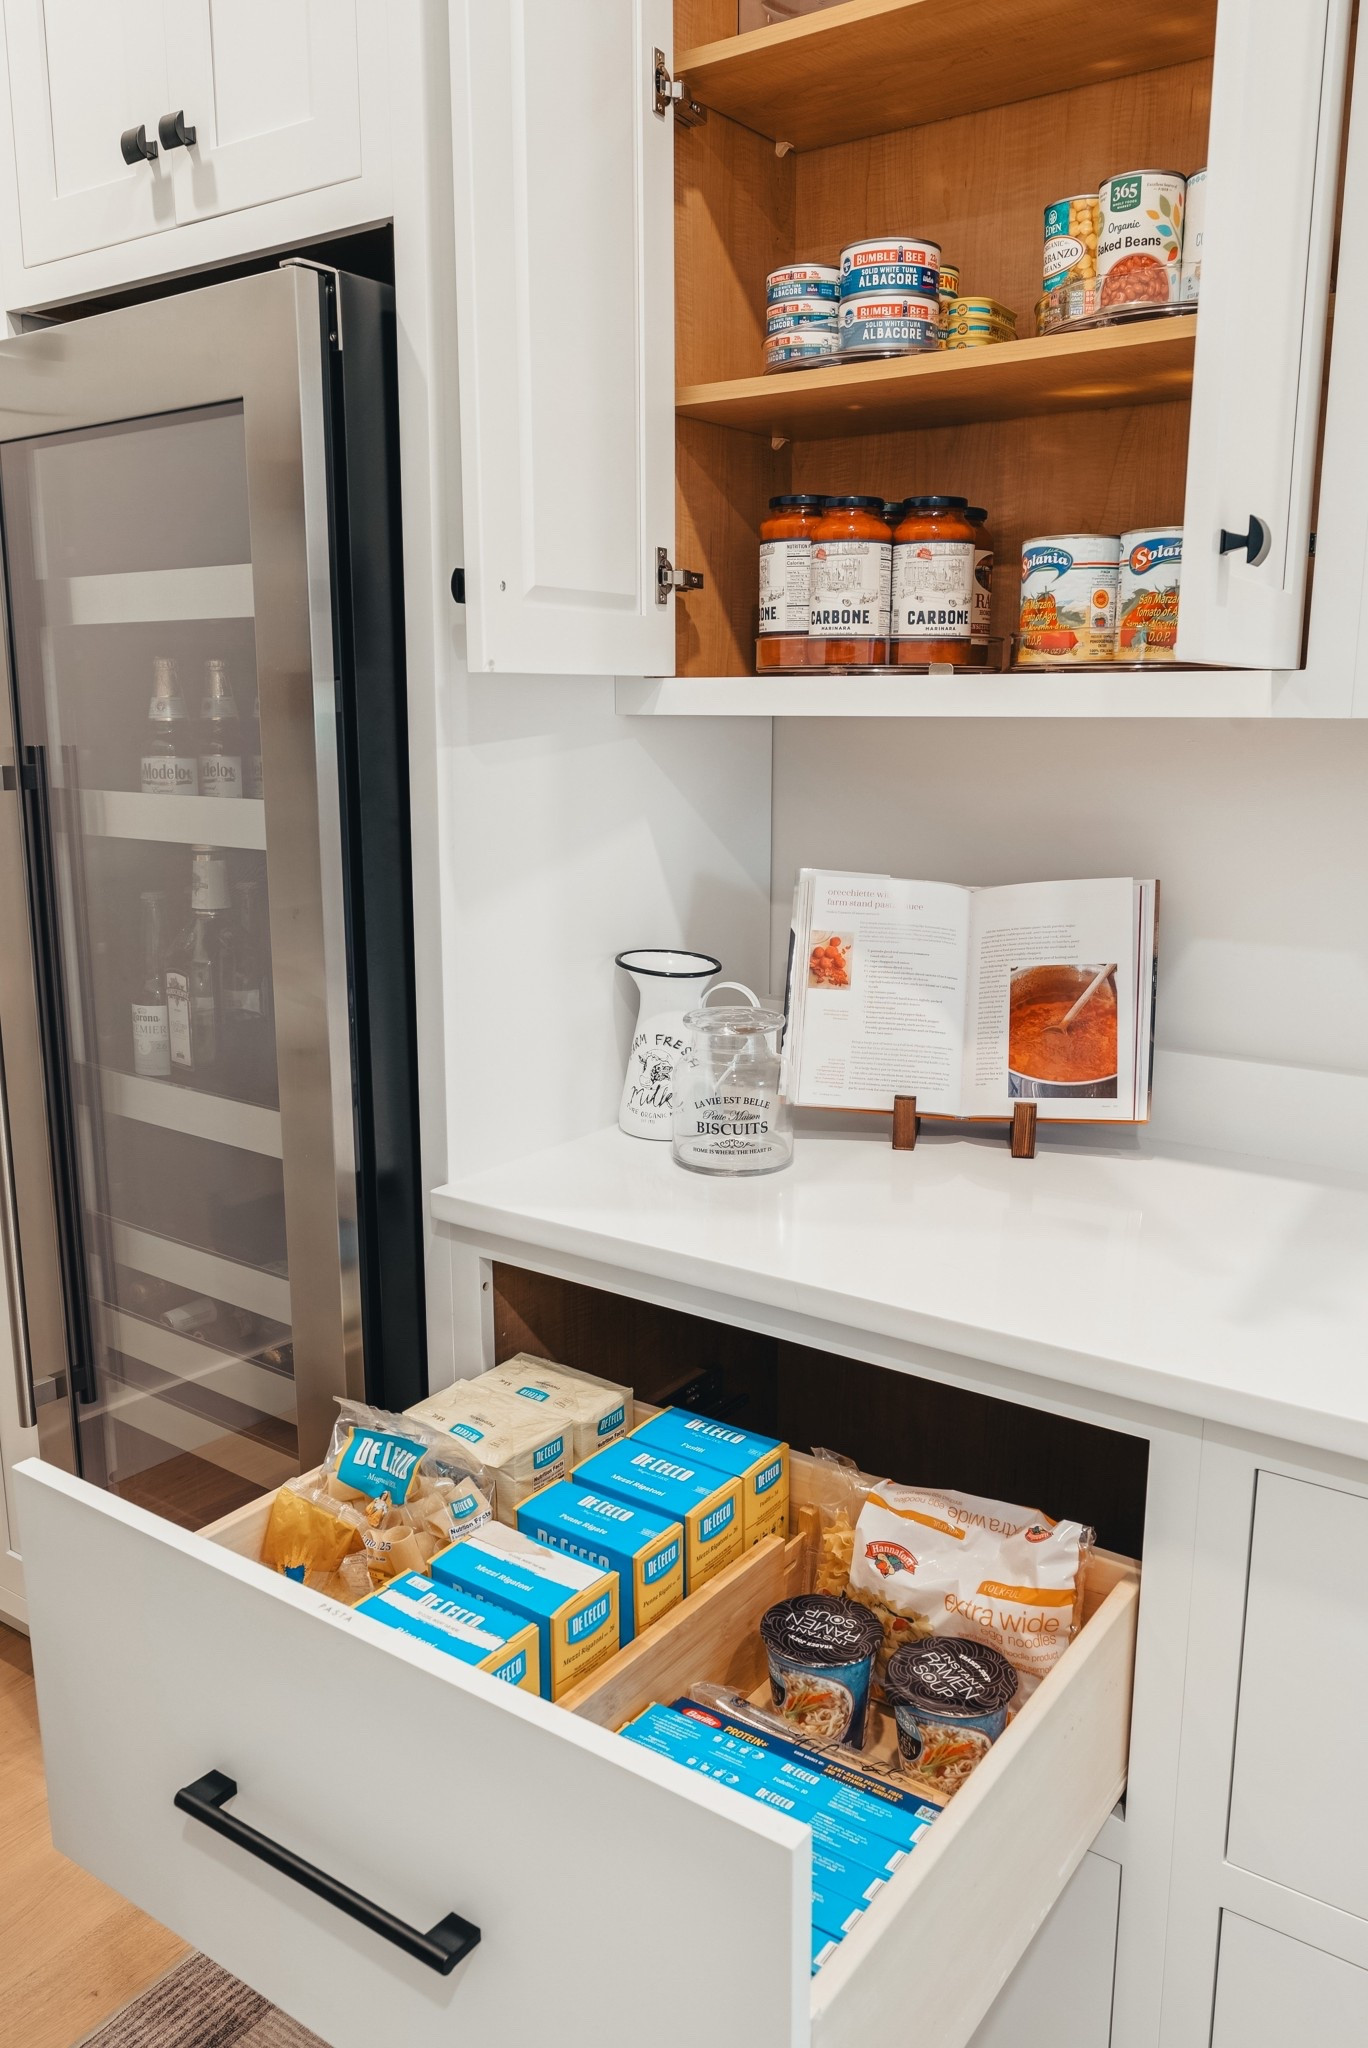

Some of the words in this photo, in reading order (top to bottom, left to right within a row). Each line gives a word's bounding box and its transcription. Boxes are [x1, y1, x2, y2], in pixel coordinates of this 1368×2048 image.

[1113, 182, 1139, 202] 365
[1045, 223, 1062, 238] EDEN
[1108, 220, 1141, 234] Organic
[1124, 236, 1161, 253] Beans
[856, 251, 896, 266] BUMBLE
[905, 251, 924, 263] BEE
[793, 272, 806, 280] BEE
[858, 273, 918, 288] ALBACORE
[861, 267, 878, 276] SOLID
[772, 287, 802, 299] ALBACORE
[906, 320, 920, 328] TUNA
[862, 327, 922, 341] ALBACORE
[1022, 553, 1069, 578] Solania
[759, 606, 777, 621] ONE
[811, 609, 870, 625] CARBONE
[907, 609, 969, 625] CARBONE
[1136, 607, 1161, 617] Tomato
[1148, 631, 1170, 642] D.O.P.
[143, 762, 188, 780] Modelo
[827, 889, 875, 899] orecchiette
[827, 898, 848, 907] farm
[849, 899, 873, 908] stand
[655, 1033, 700, 1069] FRESH
[629, 1084, 674, 1110] Milk
[694, 1100, 706, 1109] LA
[705, 1096, 722, 1106] VIE
[723, 1096, 742, 1104] EST
[743, 1096, 771, 1109] BELLE
[640, 1111, 667, 1119] ORGANIC
[702, 1109, 727, 1121] Petite
[728, 1110, 761, 1121] Maison
[696, 1120, 769, 1136] BISCUITS
[693, 1146, 708, 1154] HOME
[608, 1409, 623, 1427] CECCO
[597, 1436, 614, 1448] Nutrition
[614, 1429, 625, 1438] Facts
[684, 1418, 707, 1432] DE
[702, 1424, 747, 1444] CECCO
[353, 1437, 383, 1469] DE
[536, 1450, 545, 1464] DE
[544, 1441, 561, 1460] CECCO
[681, 1442, 706, 1454] Fusilli
[552, 1461, 564, 1471] Facts
[630, 1452, 656, 1468] DE
[648, 1459, 696, 1482] CECCO
[611, 1473, 634, 1485] Mezzi
[632, 1481, 667, 1497] Rigatoni
[758, 1475, 766, 1489] DE
[765, 1463, 780, 1484] CECCO
[577, 1494, 601, 1509] DE
[594, 1501, 635, 1522] CECCO
[927, 1498, 945, 1510] egg
[559, 1512, 583, 1526] Penne
[582, 1521, 608, 1535] Rigate
[703, 1518, 712, 1536] DE
[712, 1503, 731, 1528] CECCO
[947, 1506, 989, 1530] wide
[450, 1521, 474, 1535] Nutrition
[379, 1541, 392, 1551] 25
[648, 1558, 658, 1578] DE
[657, 1545, 676, 1571] CECCO
[474, 1563, 501, 1578] Mezzi
[498, 1573, 535, 1593] Rigatoni
[983, 1583, 1020, 1599] YOLKFUL
[318, 1602, 353, 1623] PASTA
[572, 1615, 584, 1636] DE
[583, 1598, 607, 1629] CECCO
[804, 1609, 858, 1629] SOUP
[943, 1593, 994, 1629] extra
[999, 1610, 1060, 1634] wide
[785, 1612, 861, 1643] RAMEN
[786, 1624, 848, 1646] INSTANT
[806, 1641, 833, 1650] TRADER
[980, 1628, 1004, 1645] egg
[1007, 1633, 1057, 1649] noodles
[562, 1650, 581, 1667] Mezzi
[581, 1632, 604, 1655] Rigatoni
[1003, 1649, 1030, 1661] noodle
[1031, 1650, 1060, 1662] product
[958, 1653, 981, 1670] TRADER
[921, 1651, 980, 1700] RAMEN
[940, 1652, 985, 1690] INSTANT
[912, 1664, 955, 1698] SOUP
[686, 1709, 719, 1728] Barilla
[723, 1725, 769, 1748] PROTEIN+
[780, 1762, 796, 1774] DE
[792, 1768, 821, 1786] CECCO
[823, 1767, 837, 1776] AND
[841, 1775, 867, 1789] VITAMINS
[827, 1764, 864, 1782] PLANT-BASED
[755, 1787, 770, 1800] DE
[766, 1792, 796, 1811] CECCO
